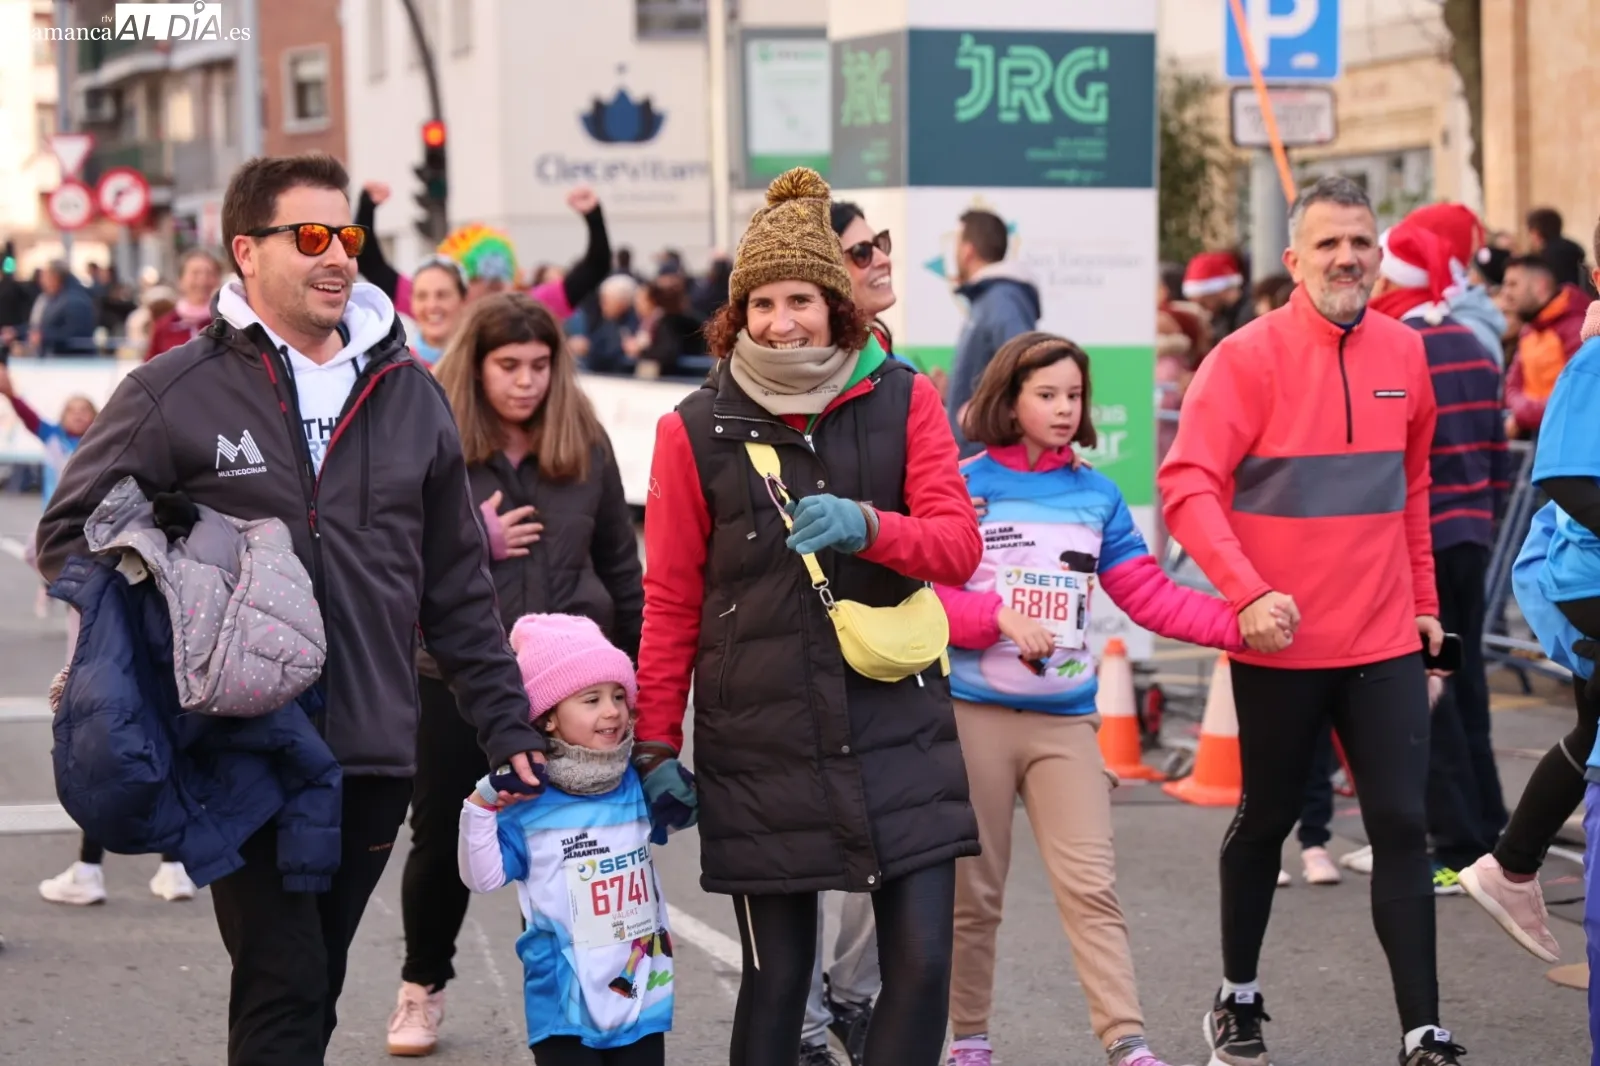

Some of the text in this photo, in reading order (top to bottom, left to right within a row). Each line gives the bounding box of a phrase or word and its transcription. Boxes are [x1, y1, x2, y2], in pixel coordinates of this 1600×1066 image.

[1249, 0, 1319, 71] P
[955, 33, 1109, 124] JRG
[303, 417, 341, 440] TH
[218, 466, 267, 477] MULTICOCINAS
[1011, 588, 1069, 621] 6818
[591, 868, 649, 916] 6741
